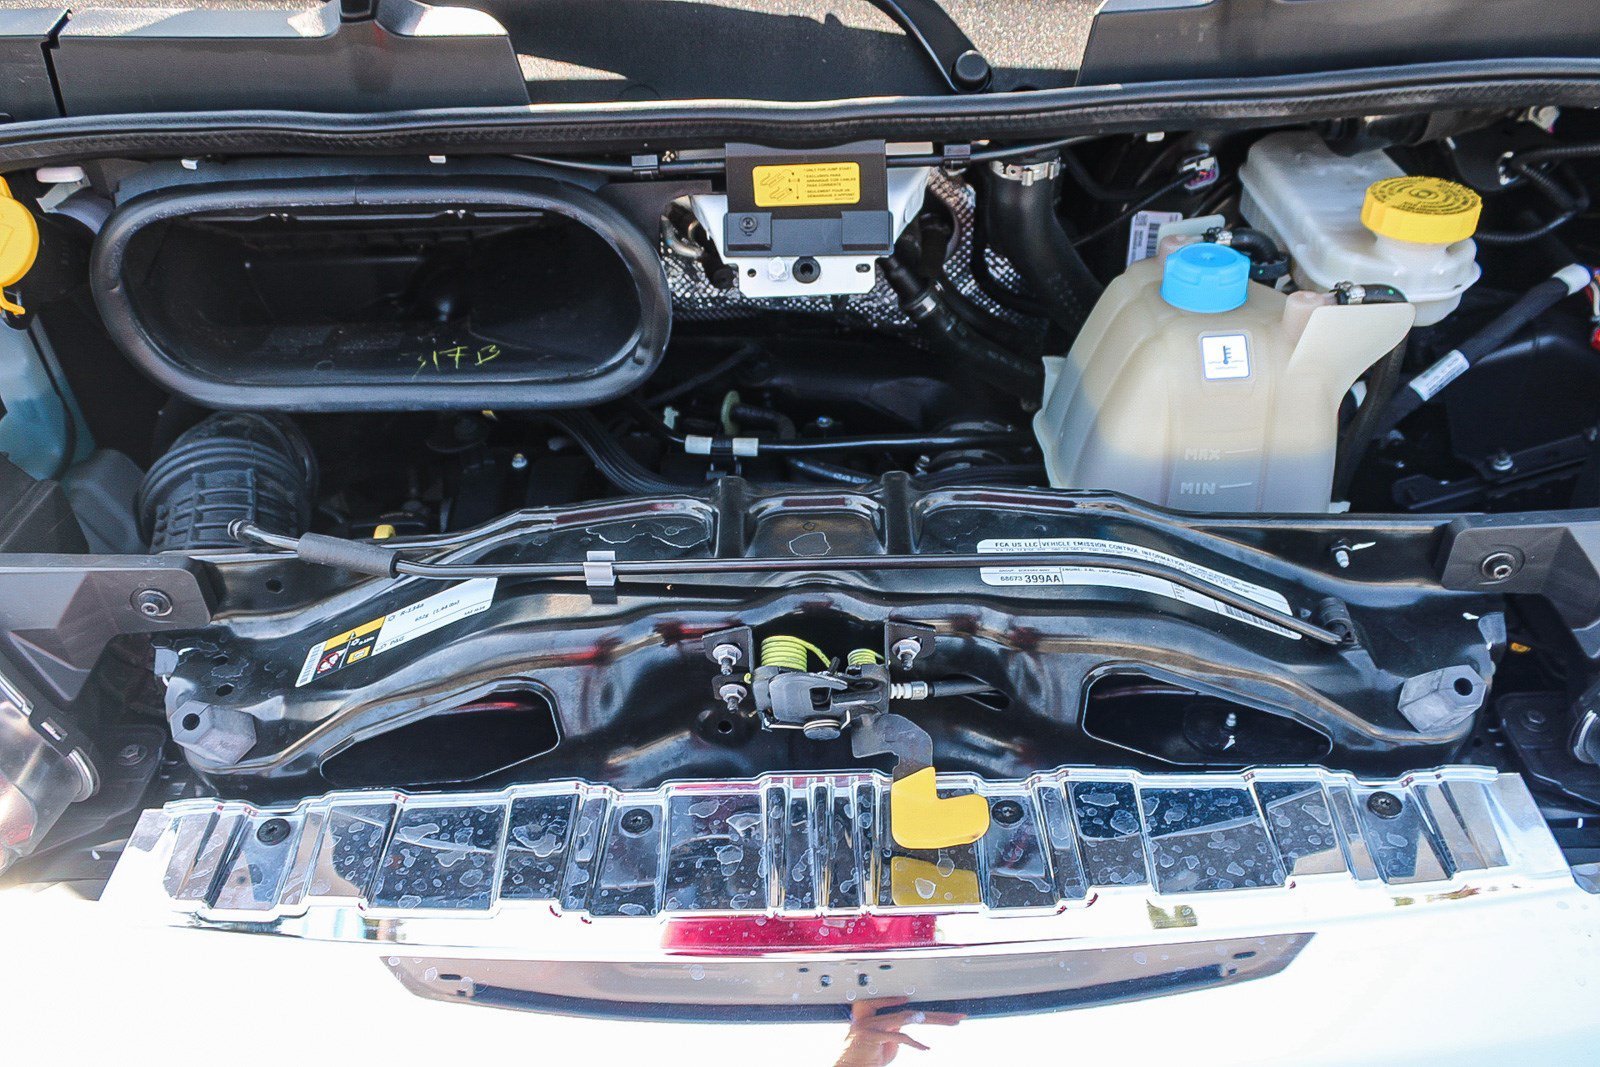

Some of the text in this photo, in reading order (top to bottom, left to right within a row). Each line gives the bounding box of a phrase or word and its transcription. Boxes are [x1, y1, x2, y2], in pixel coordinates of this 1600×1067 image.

[1184, 447, 1221, 461] MAX
[1180, 482, 1216, 495] MIN
[1073, 540, 1107, 549] EMISSION
[1024, 574, 1061, 584] 399AA
